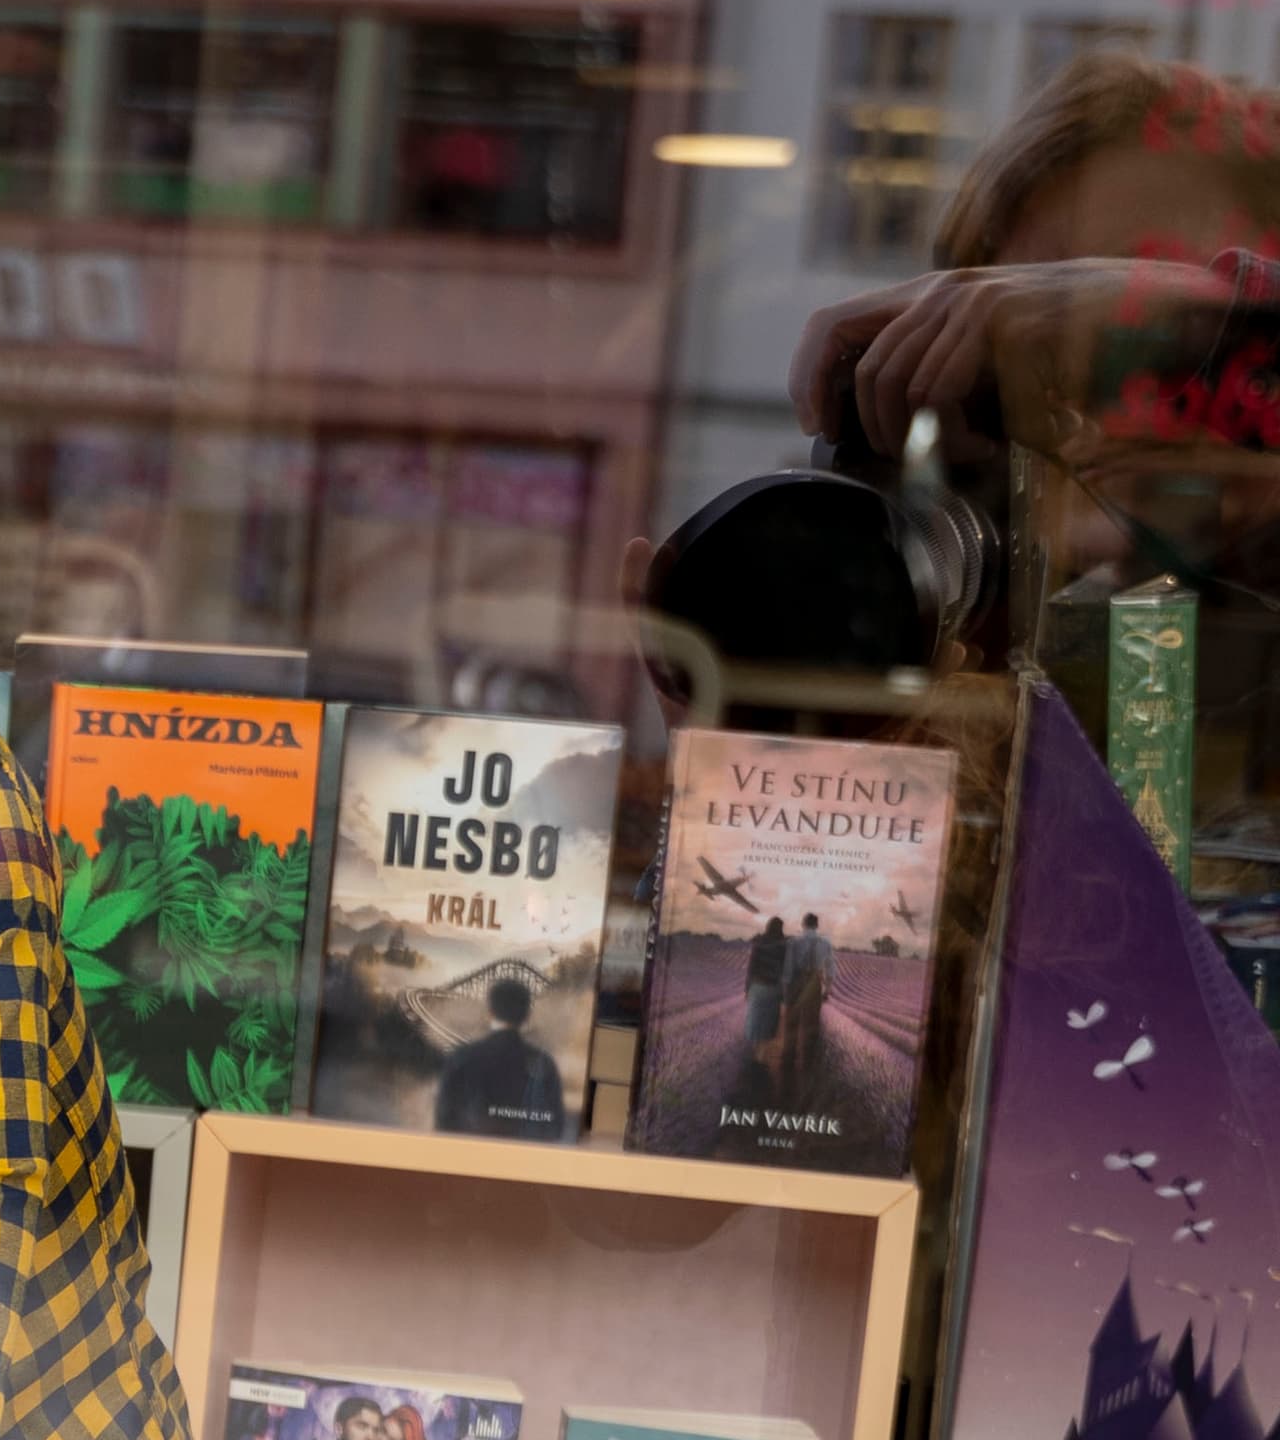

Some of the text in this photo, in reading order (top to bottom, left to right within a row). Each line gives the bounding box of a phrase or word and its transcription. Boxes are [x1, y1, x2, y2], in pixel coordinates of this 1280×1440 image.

[72, 706, 302, 749] HNÍZDA
[443, 749, 514, 809] JO
[731, 764, 908, 806] VE STÍNU
[706, 800, 925, 845] LEVANDULE
[384, 812, 562, 882] NESBØ
[427, 892, 502, 931] KRÁL
